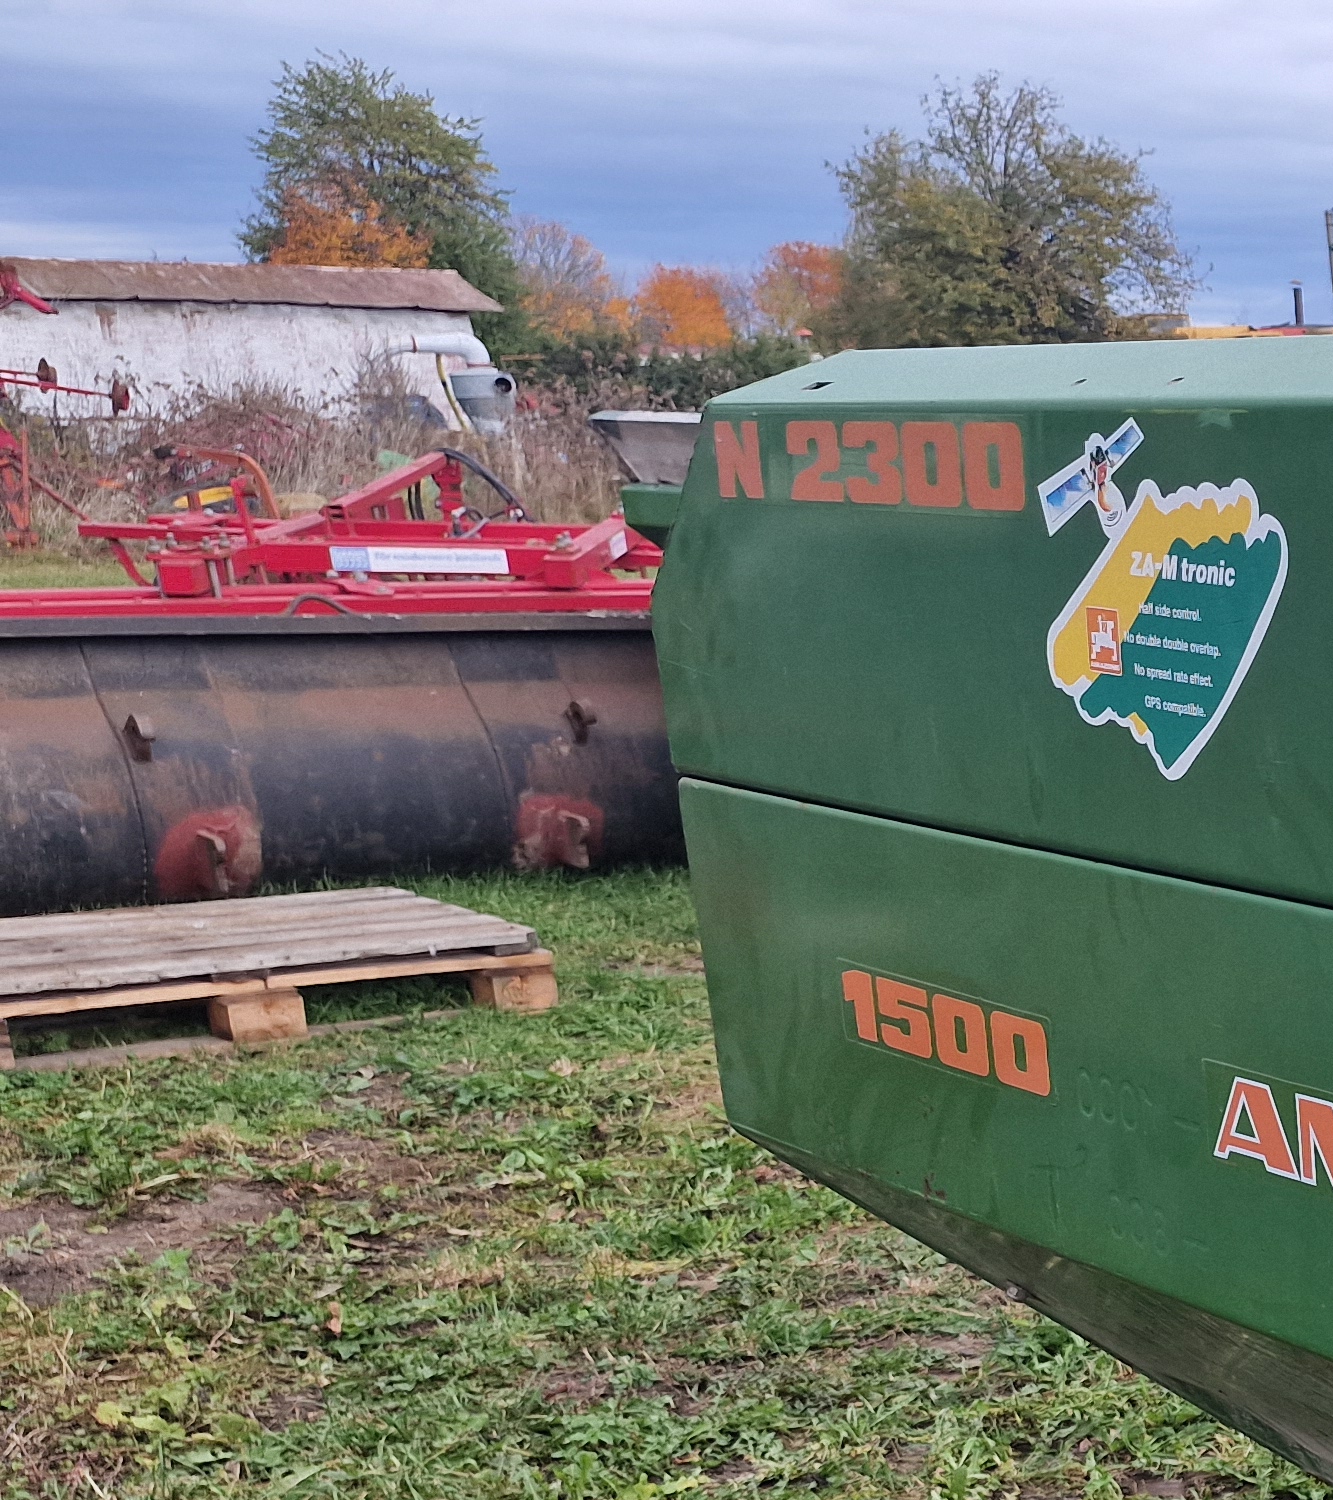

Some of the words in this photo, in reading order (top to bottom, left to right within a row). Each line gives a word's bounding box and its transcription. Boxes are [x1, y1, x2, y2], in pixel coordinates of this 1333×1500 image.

[714, 421, 764, 498] N
[785, 420, 1026, 512] 2300
[1130, 551, 1178, 581] ZA-M
[1181, 558, 1236, 587] tronic
[1155, 603, 1171, 618] side
[1172, 608, 1202, 622] control.
[1123, 630, 1135, 643] No
[1136, 632, 1161, 648] double
[1162, 636, 1189, 651] double
[1190, 642, 1222, 659] overlap.
[1134, 662, 1145, 676] No
[1146, 668, 1172, 680] spread
[1173, 671, 1188, 683] rate
[1144, 695, 1161, 710] GPS
[841, 969, 1051, 1097] 1500
